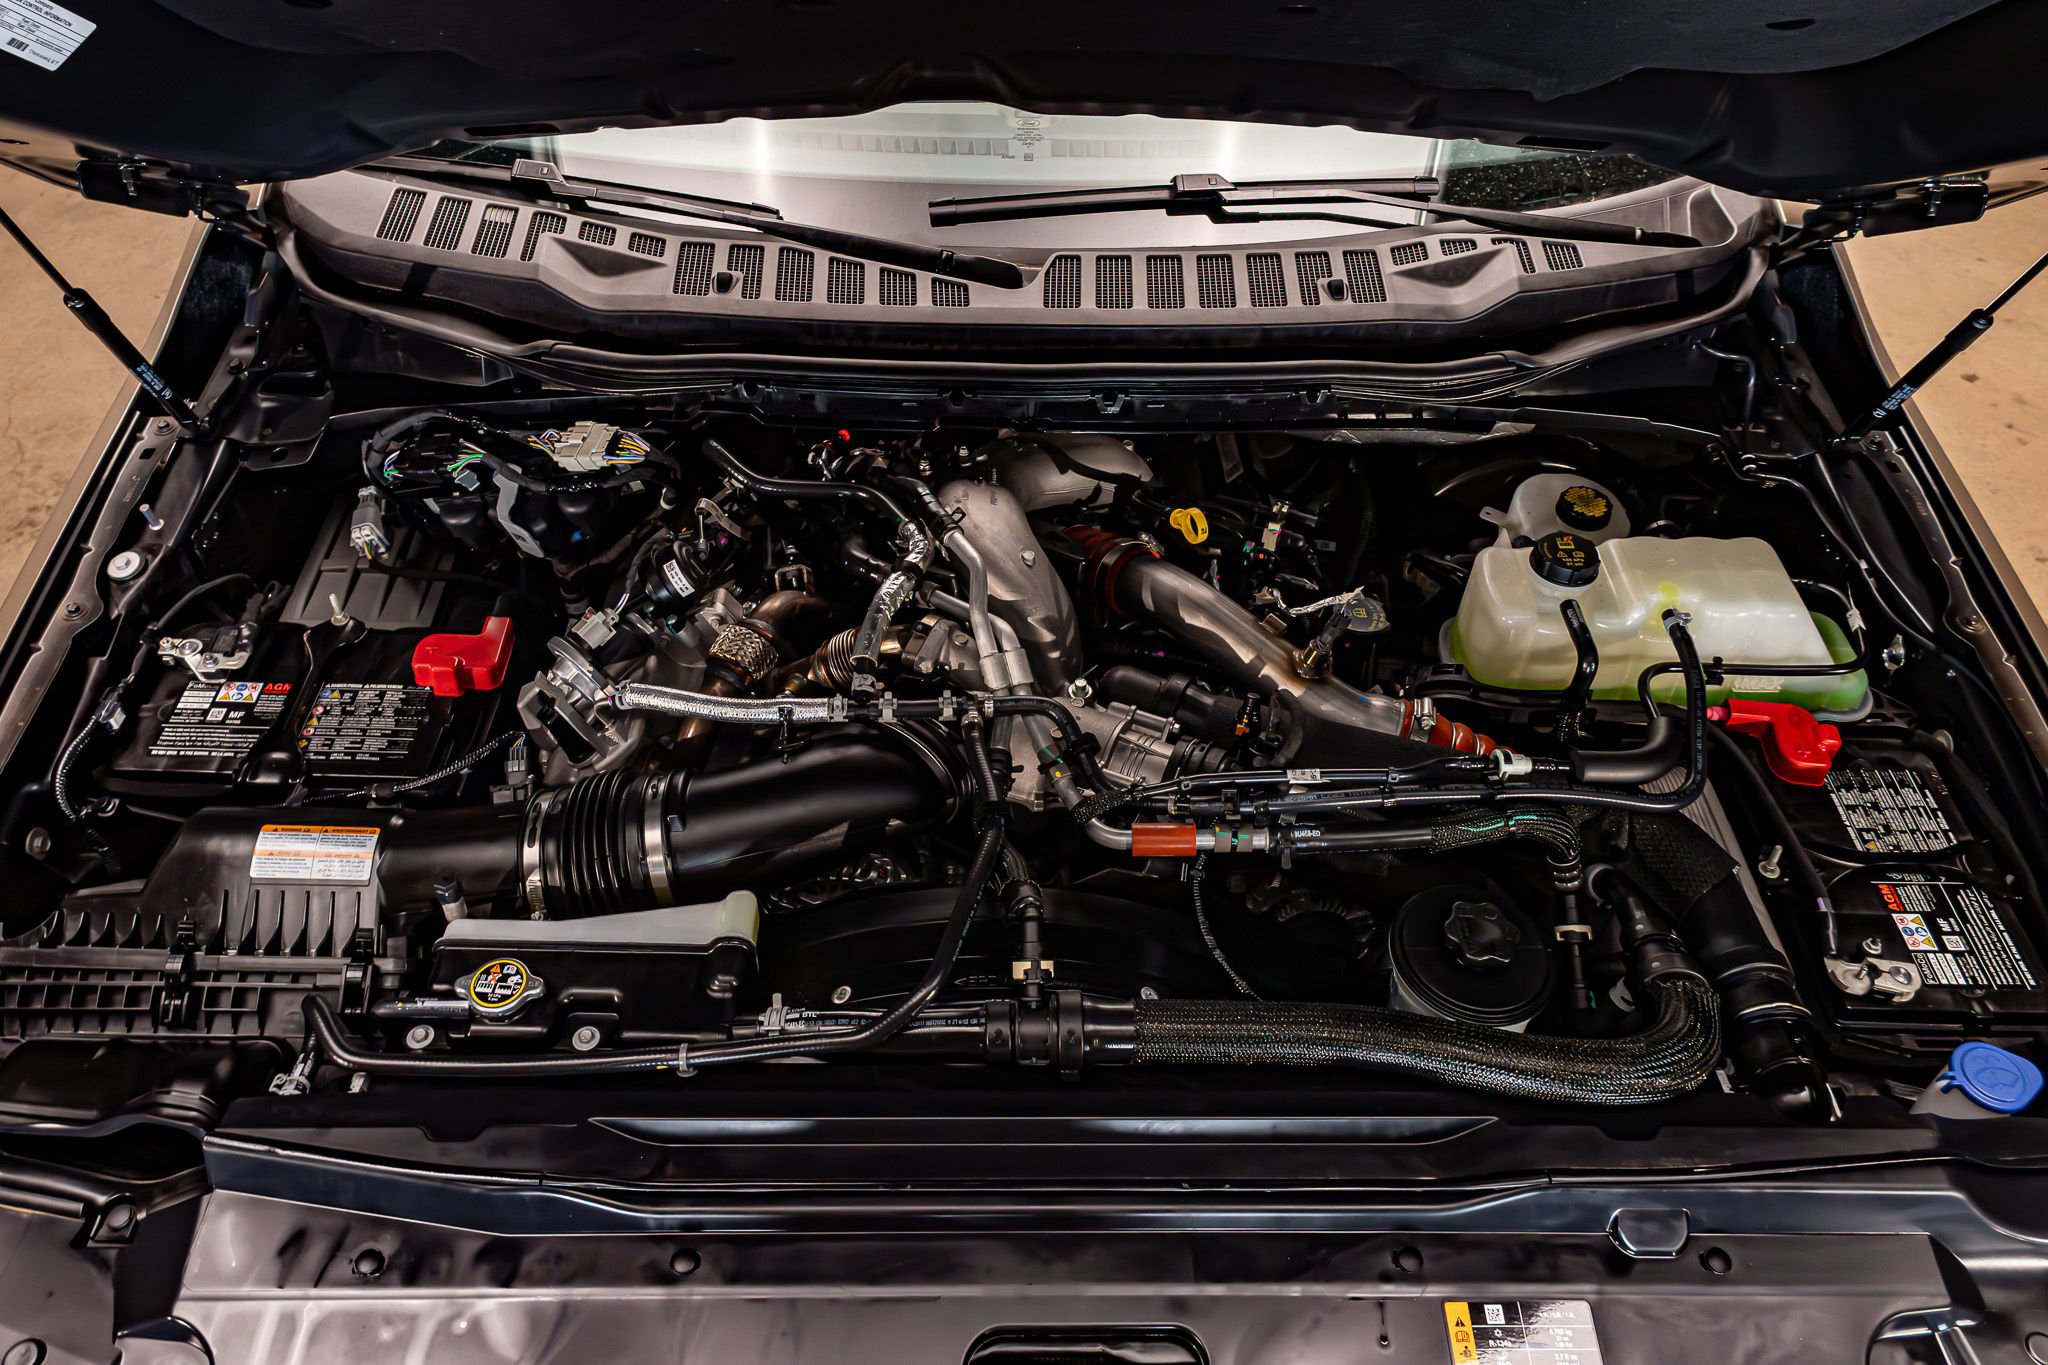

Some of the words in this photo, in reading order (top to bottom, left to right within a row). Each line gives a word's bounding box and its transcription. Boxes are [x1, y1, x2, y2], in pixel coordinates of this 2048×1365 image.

[22, 0, 43, 13] CONTROL
[43, 11, 73, 27] INFORMATION
[228, 711, 246, 719] MF
[1878, 884, 1899, 911] AGM
[1936, 918, 1952, 931] MF
[1916, 954, 1935, 984] FoMoCo
